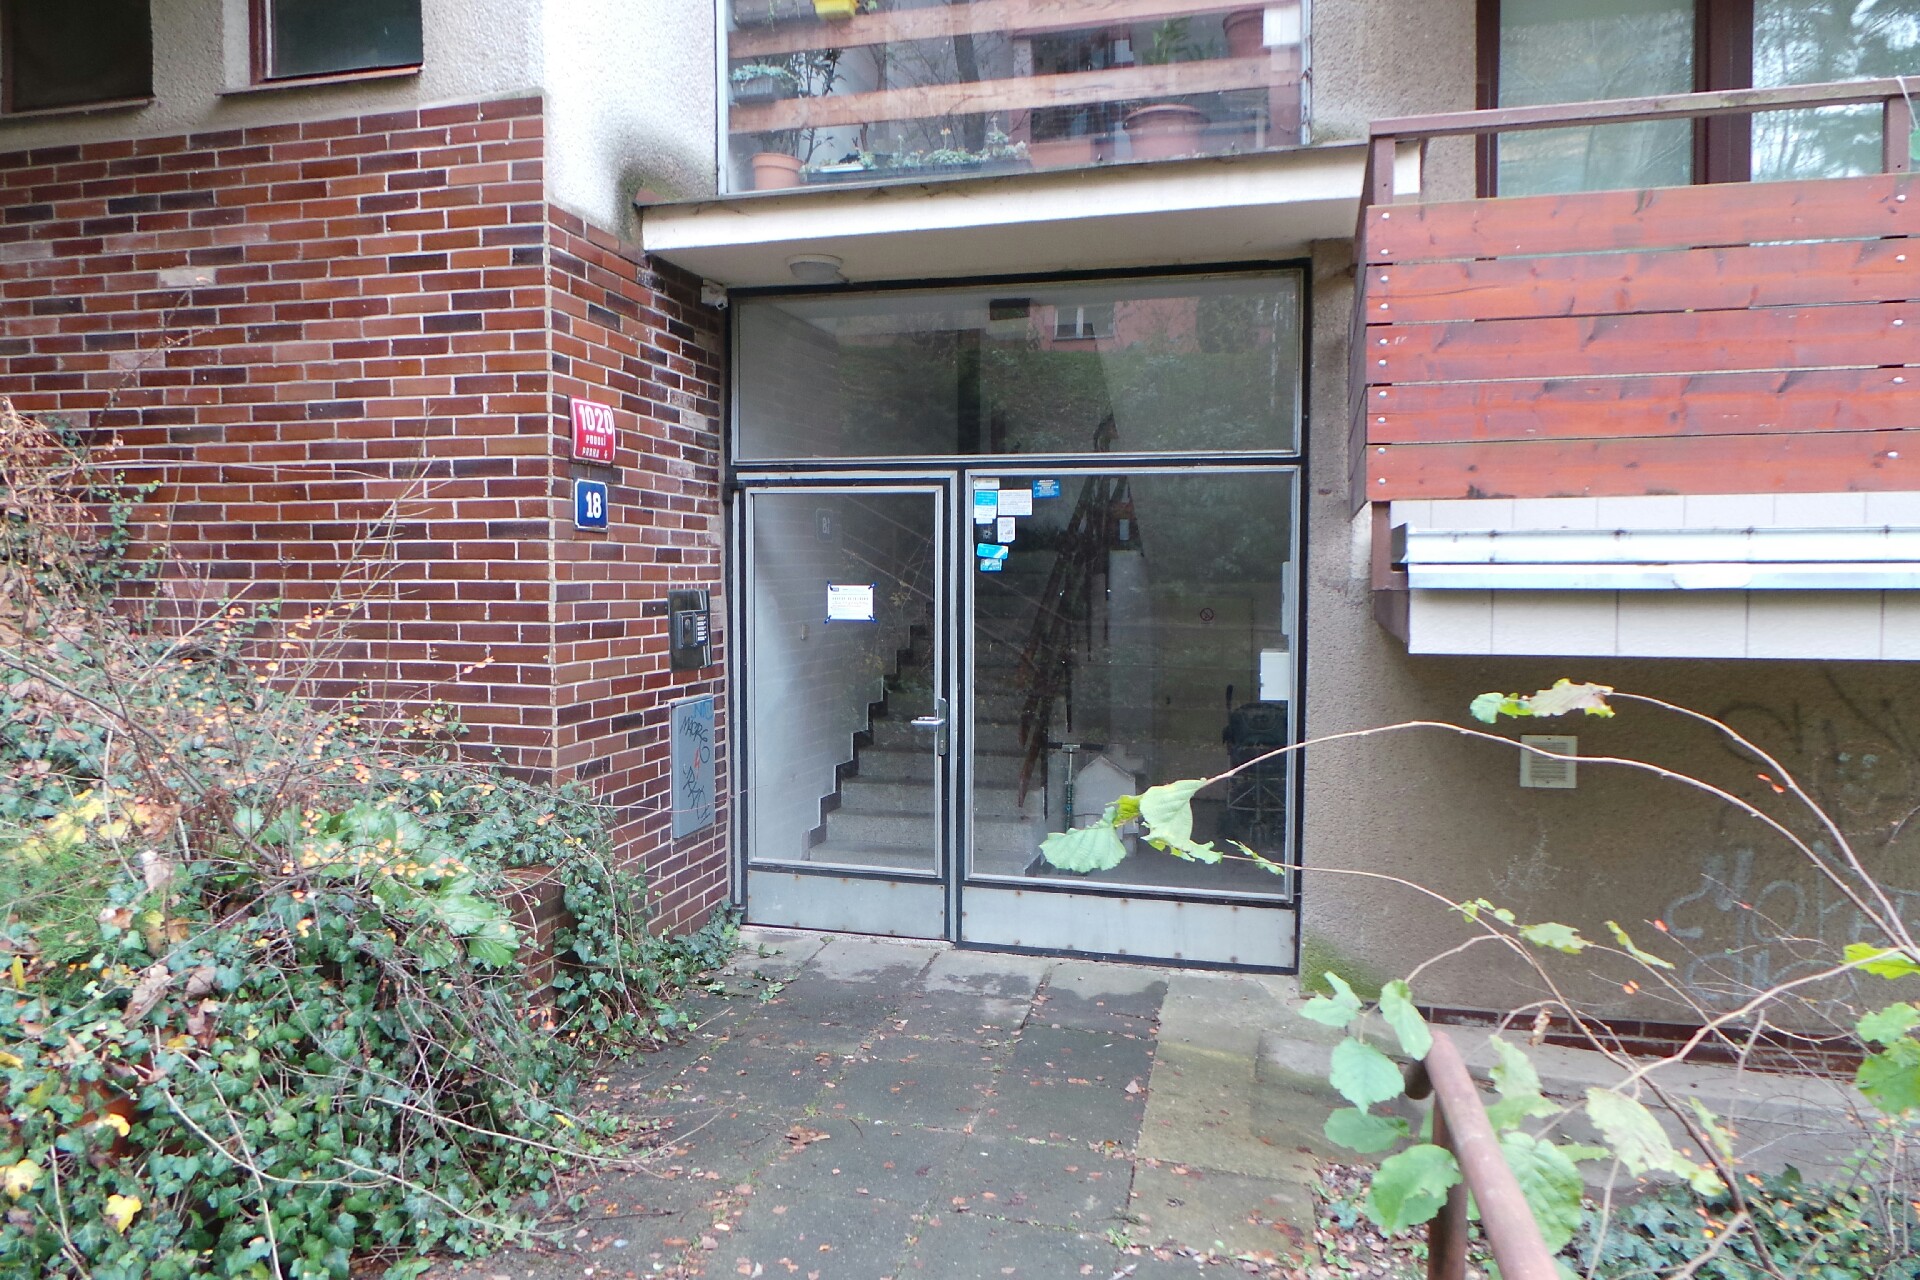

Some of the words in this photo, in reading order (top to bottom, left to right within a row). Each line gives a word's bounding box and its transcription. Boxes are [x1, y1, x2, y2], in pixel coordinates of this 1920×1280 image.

[578, 404, 613, 435] 1020
[582, 446, 600, 458] PRAHA
[586, 491, 602, 518] 18
